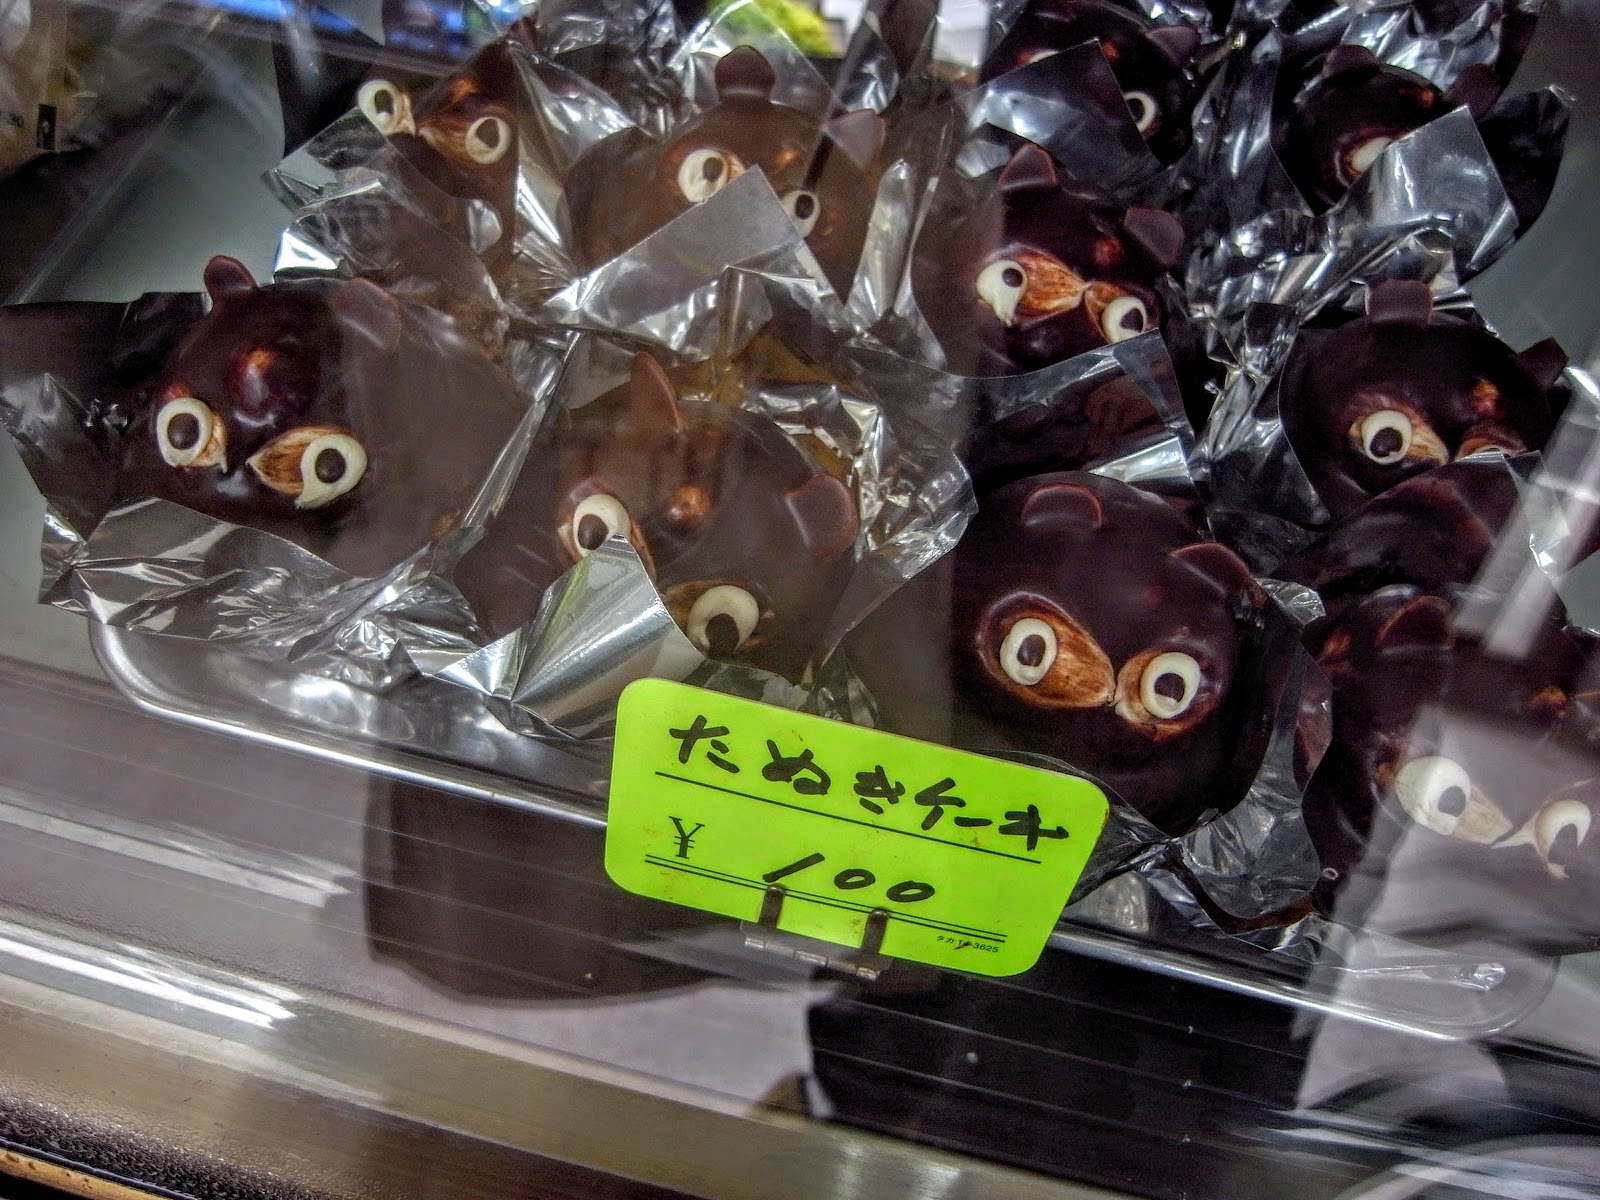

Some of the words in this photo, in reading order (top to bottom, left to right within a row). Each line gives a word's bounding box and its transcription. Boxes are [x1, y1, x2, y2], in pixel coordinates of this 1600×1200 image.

[669, 715, 1069, 851] たぬきケーキ
[762, 853, 936, 902] 100
